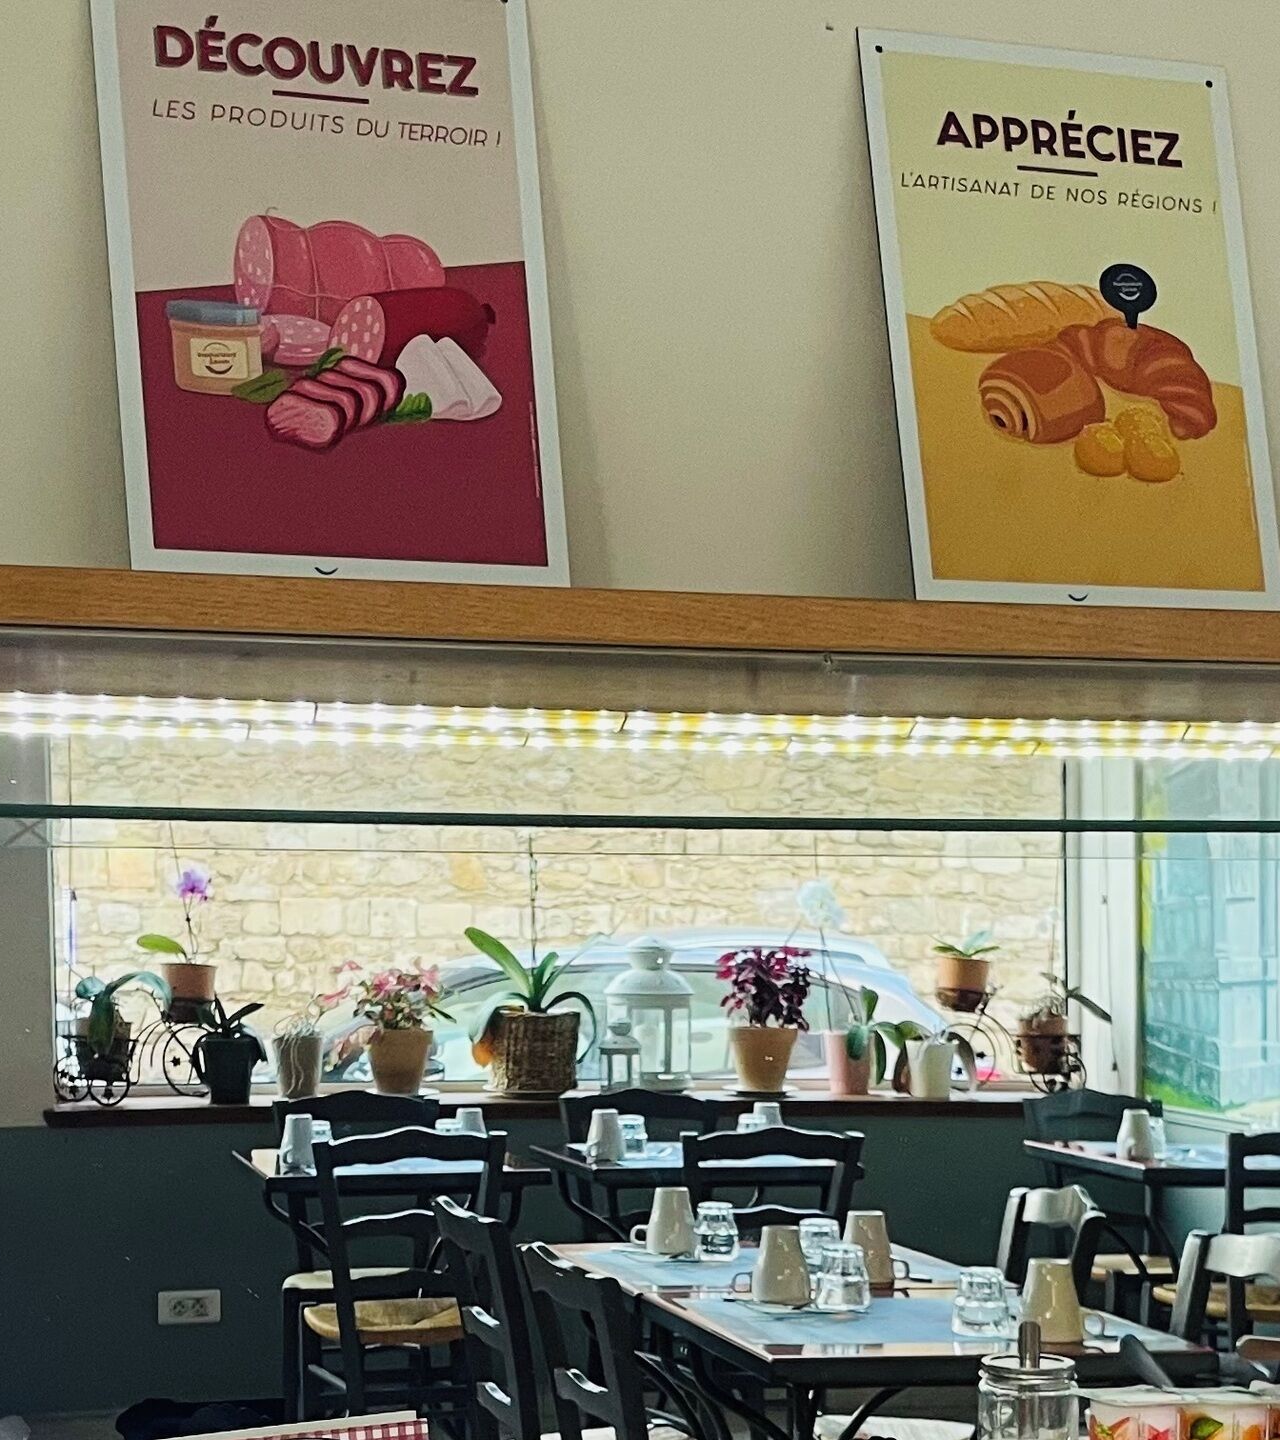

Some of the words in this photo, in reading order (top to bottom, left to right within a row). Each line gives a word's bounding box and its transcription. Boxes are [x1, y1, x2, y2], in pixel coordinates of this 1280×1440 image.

[153, 15, 480, 97] DÉCOUVREZ
[152, 98, 196, 122] LES
[210, 104, 345, 135] PRODUITS
[356, 118, 390, 139] DU
[398, 121, 488, 147] TERROIR
[936, 109, 1183, 169] APPRÉCIEZ
[900, 172, 1020, 198] L'ARTISANAT
[1031, 183, 1056, 201] DE
[1066, 186, 1107, 206] NOS
[1117, 188, 1202, 214] RÉGIONS
